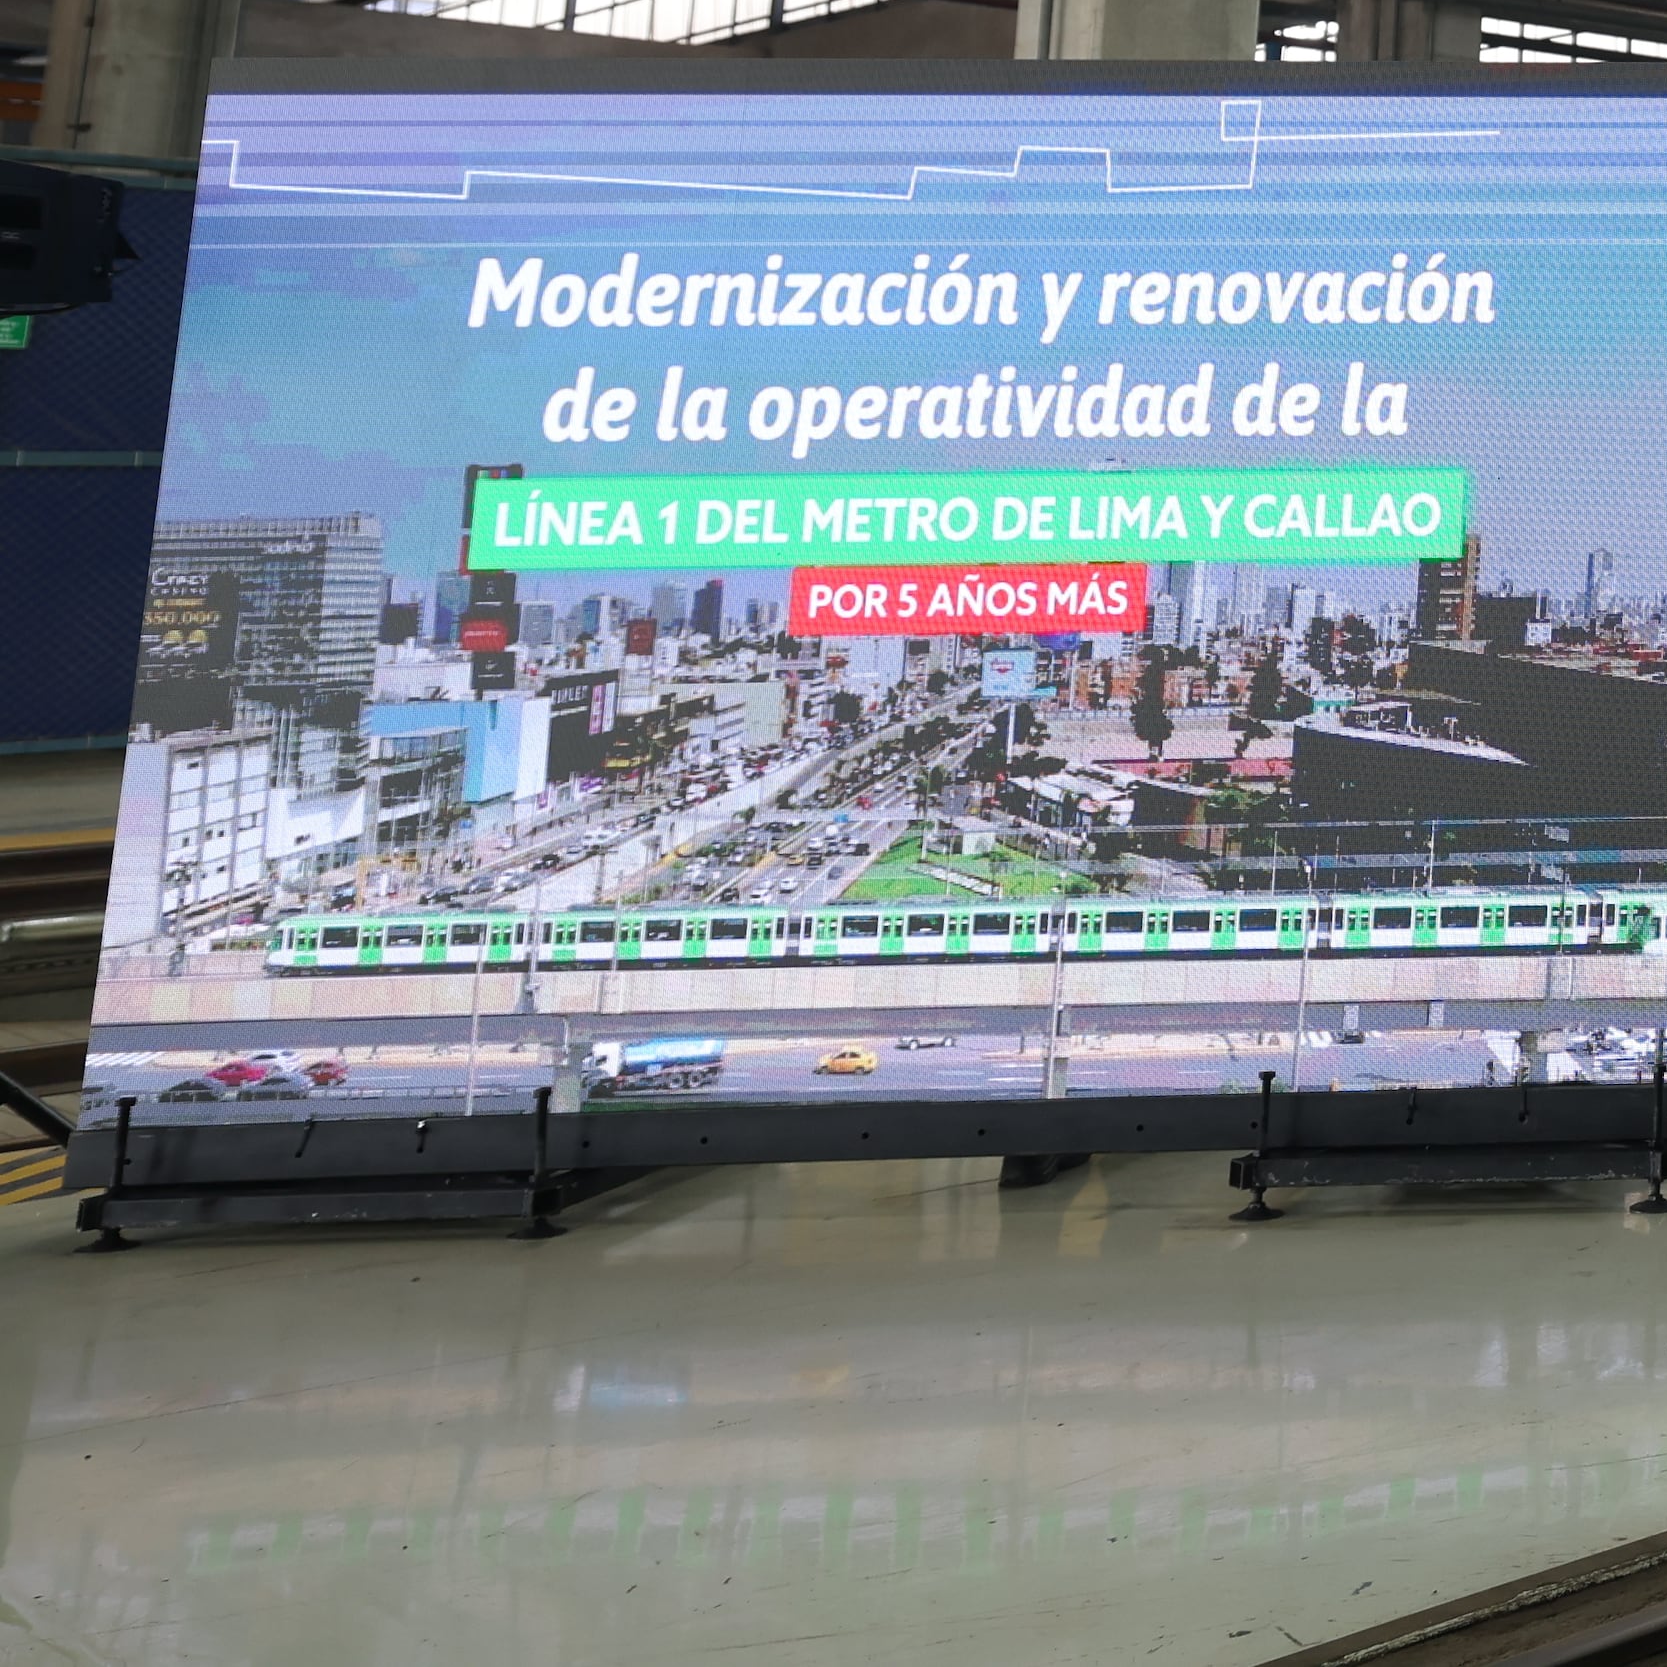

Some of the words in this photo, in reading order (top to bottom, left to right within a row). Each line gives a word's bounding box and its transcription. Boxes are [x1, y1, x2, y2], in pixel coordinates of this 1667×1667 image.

[467, 252, 1019, 328] Modernización
[1039, 271, 1083, 345] y
[1098, 252, 1496, 325] renovación
[542, 365, 638, 443] de
[655, 365, 729, 442] la
[748, 362, 1215, 460] operatividad
[1231, 361, 1321, 437] de
[1340, 361, 1409, 436] la
[493, 489, 645, 548] LÍNEA
[657, 500, 679, 545] 1
[694, 499, 789, 544] DEL
[801, 496, 980, 543] METRO
[991, 496, 1056, 542] DE
[1068, 495, 1189, 541] LIMA
[1199, 493, 1236, 539] Y
[1243, 491, 1442, 539] CALLAO
[806, 583, 888, 619] POR
[896, 582, 917, 618] 5
[925, 573, 1038, 618] AÑOS
[1046, 573, 1129, 617] MÁS
